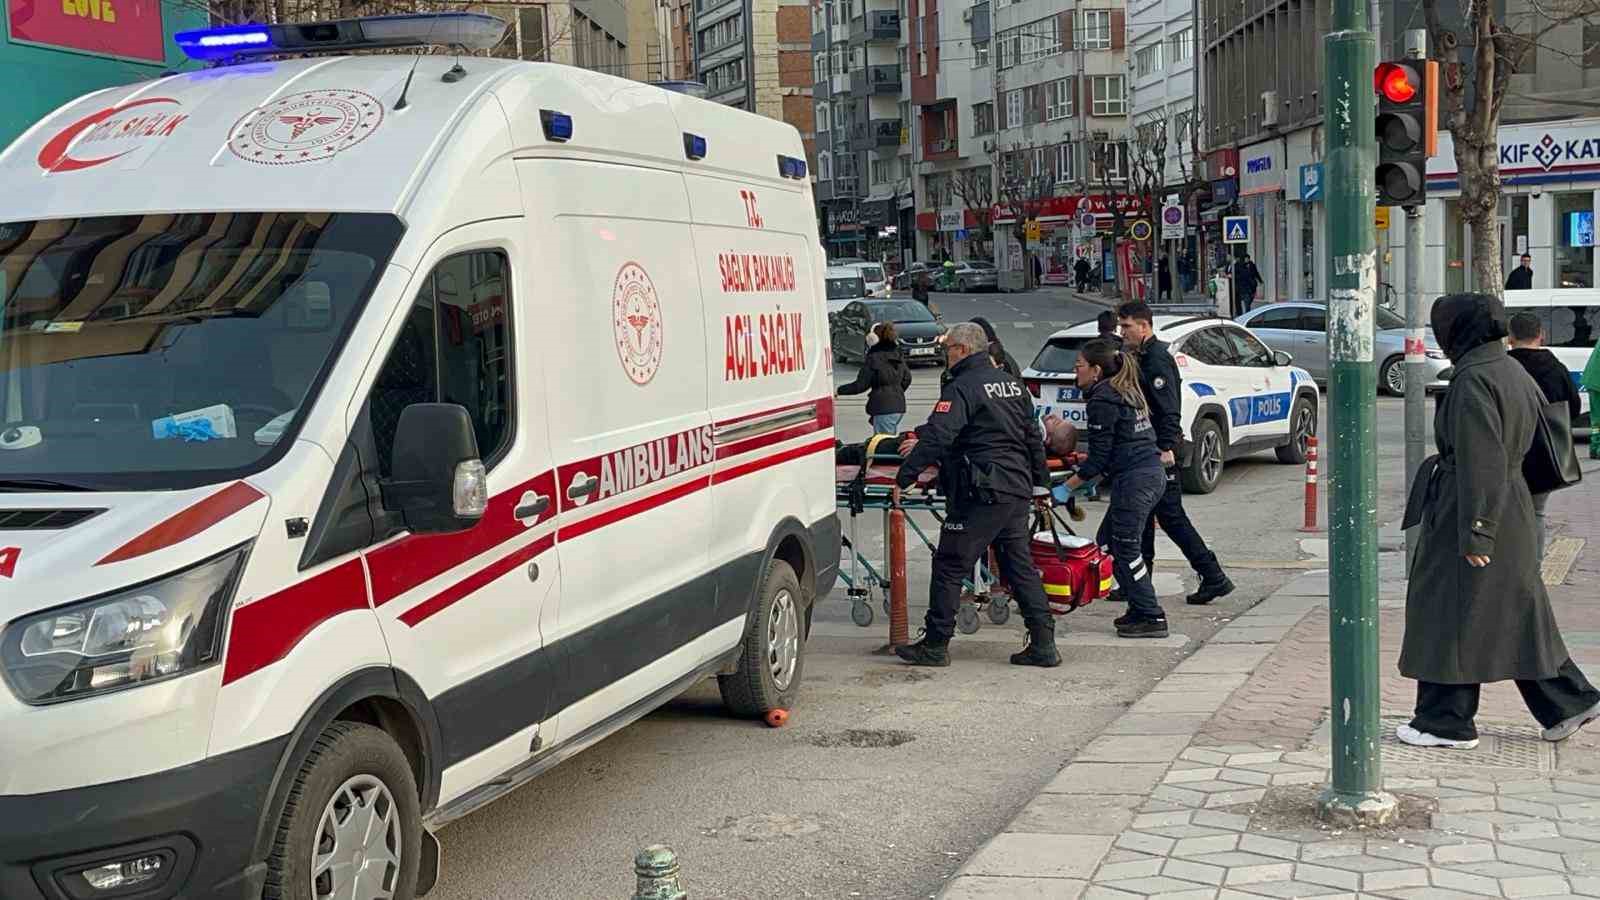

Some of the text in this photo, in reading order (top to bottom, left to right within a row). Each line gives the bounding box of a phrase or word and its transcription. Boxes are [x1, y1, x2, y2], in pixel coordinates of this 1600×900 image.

[62, 0, 117, 23] LOVE
[740, 190, 764, 228] T.C.
[718, 249, 797, 292] SAĞLIK BAKANLIĞI
[725, 313, 758, 381] ACİL
[759, 304, 806, 377] SAĞLIK
[598, 424, 715, 499] AMBULANS
